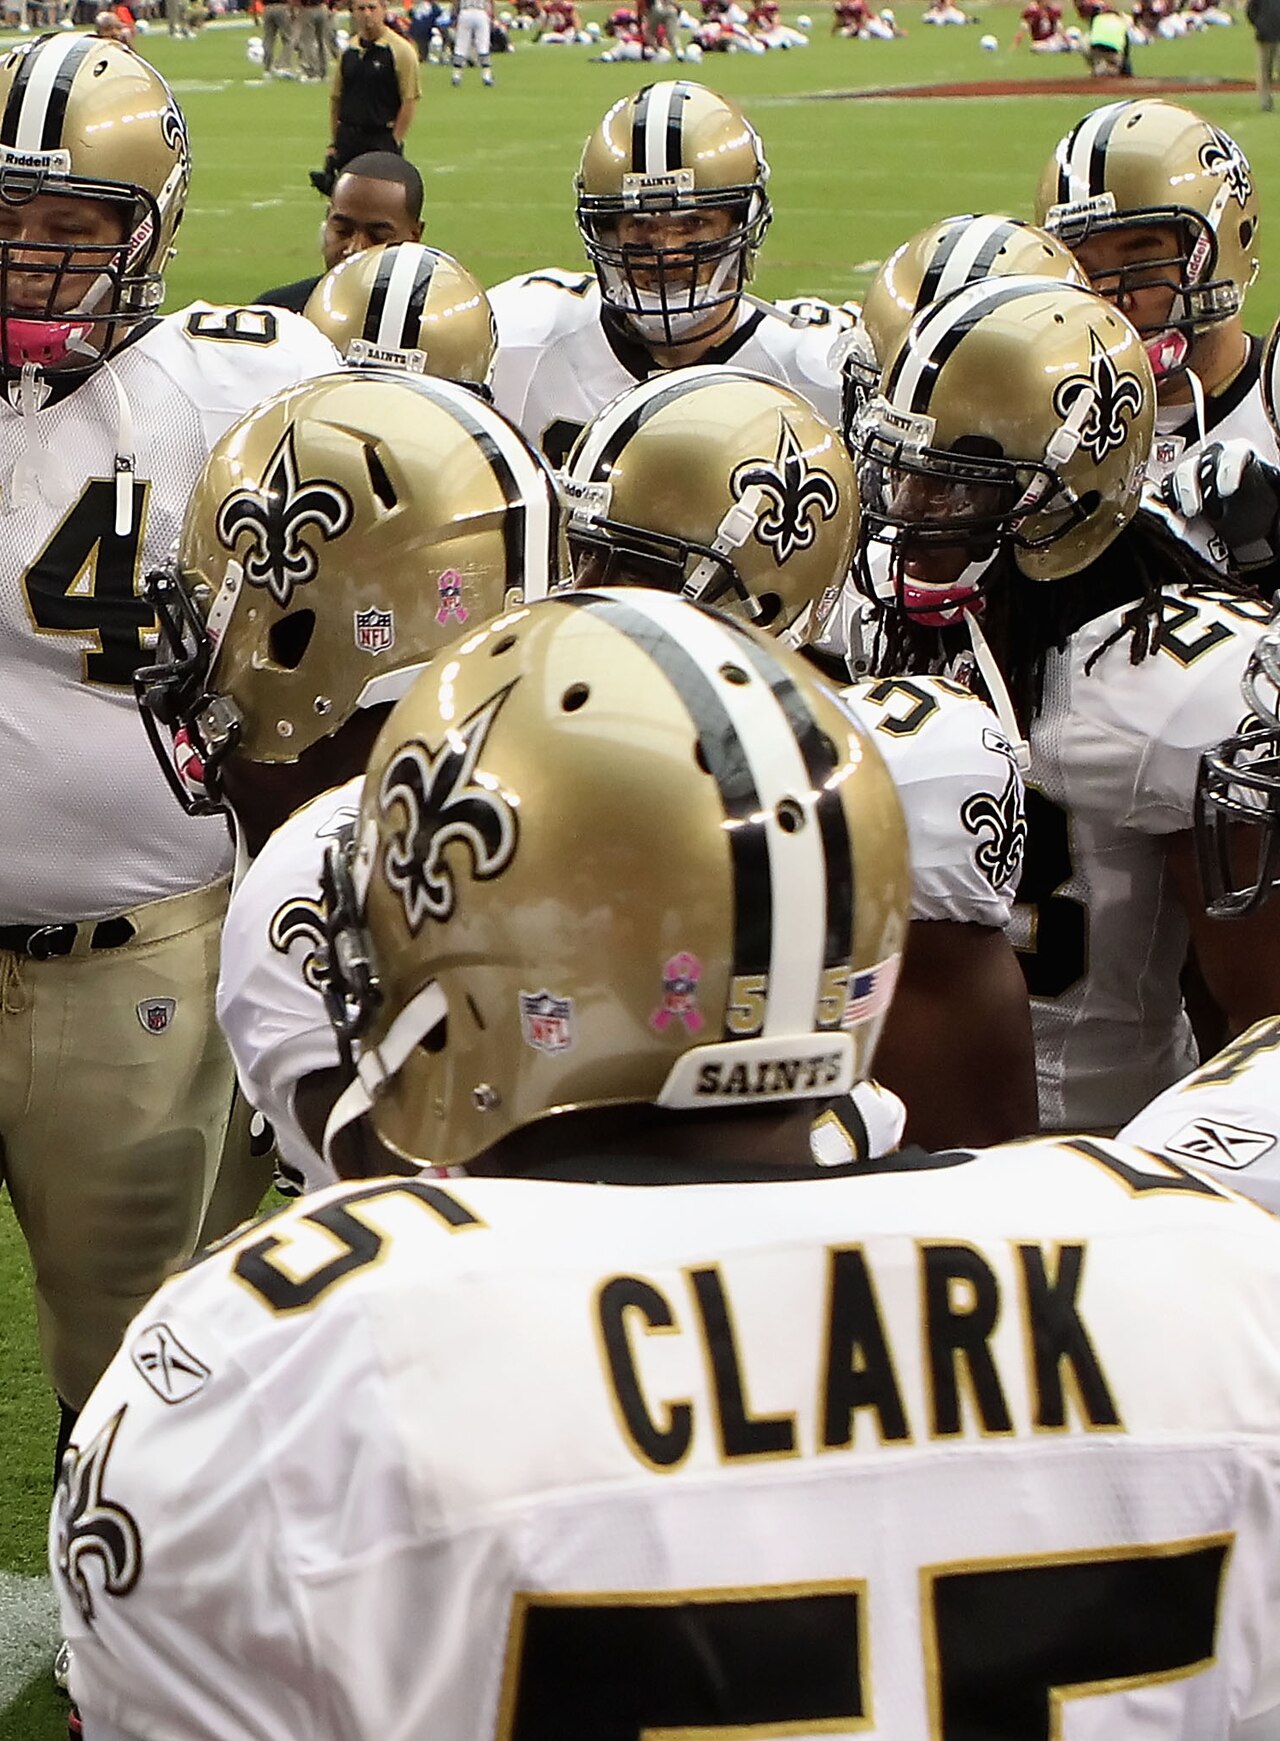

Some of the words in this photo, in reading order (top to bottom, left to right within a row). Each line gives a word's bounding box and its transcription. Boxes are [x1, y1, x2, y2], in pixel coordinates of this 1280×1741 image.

[5, 154, 50, 167] Riddell
[367, 348, 407, 365] SAINTS
[361, 628, 390, 646] NFL
[727, 974, 767, 1035] 5
[816, 965, 851, 1027] 5
[696, 1052, 843, 1096] SAINTS
[588, 1236, 1129, 1475] CLARK
